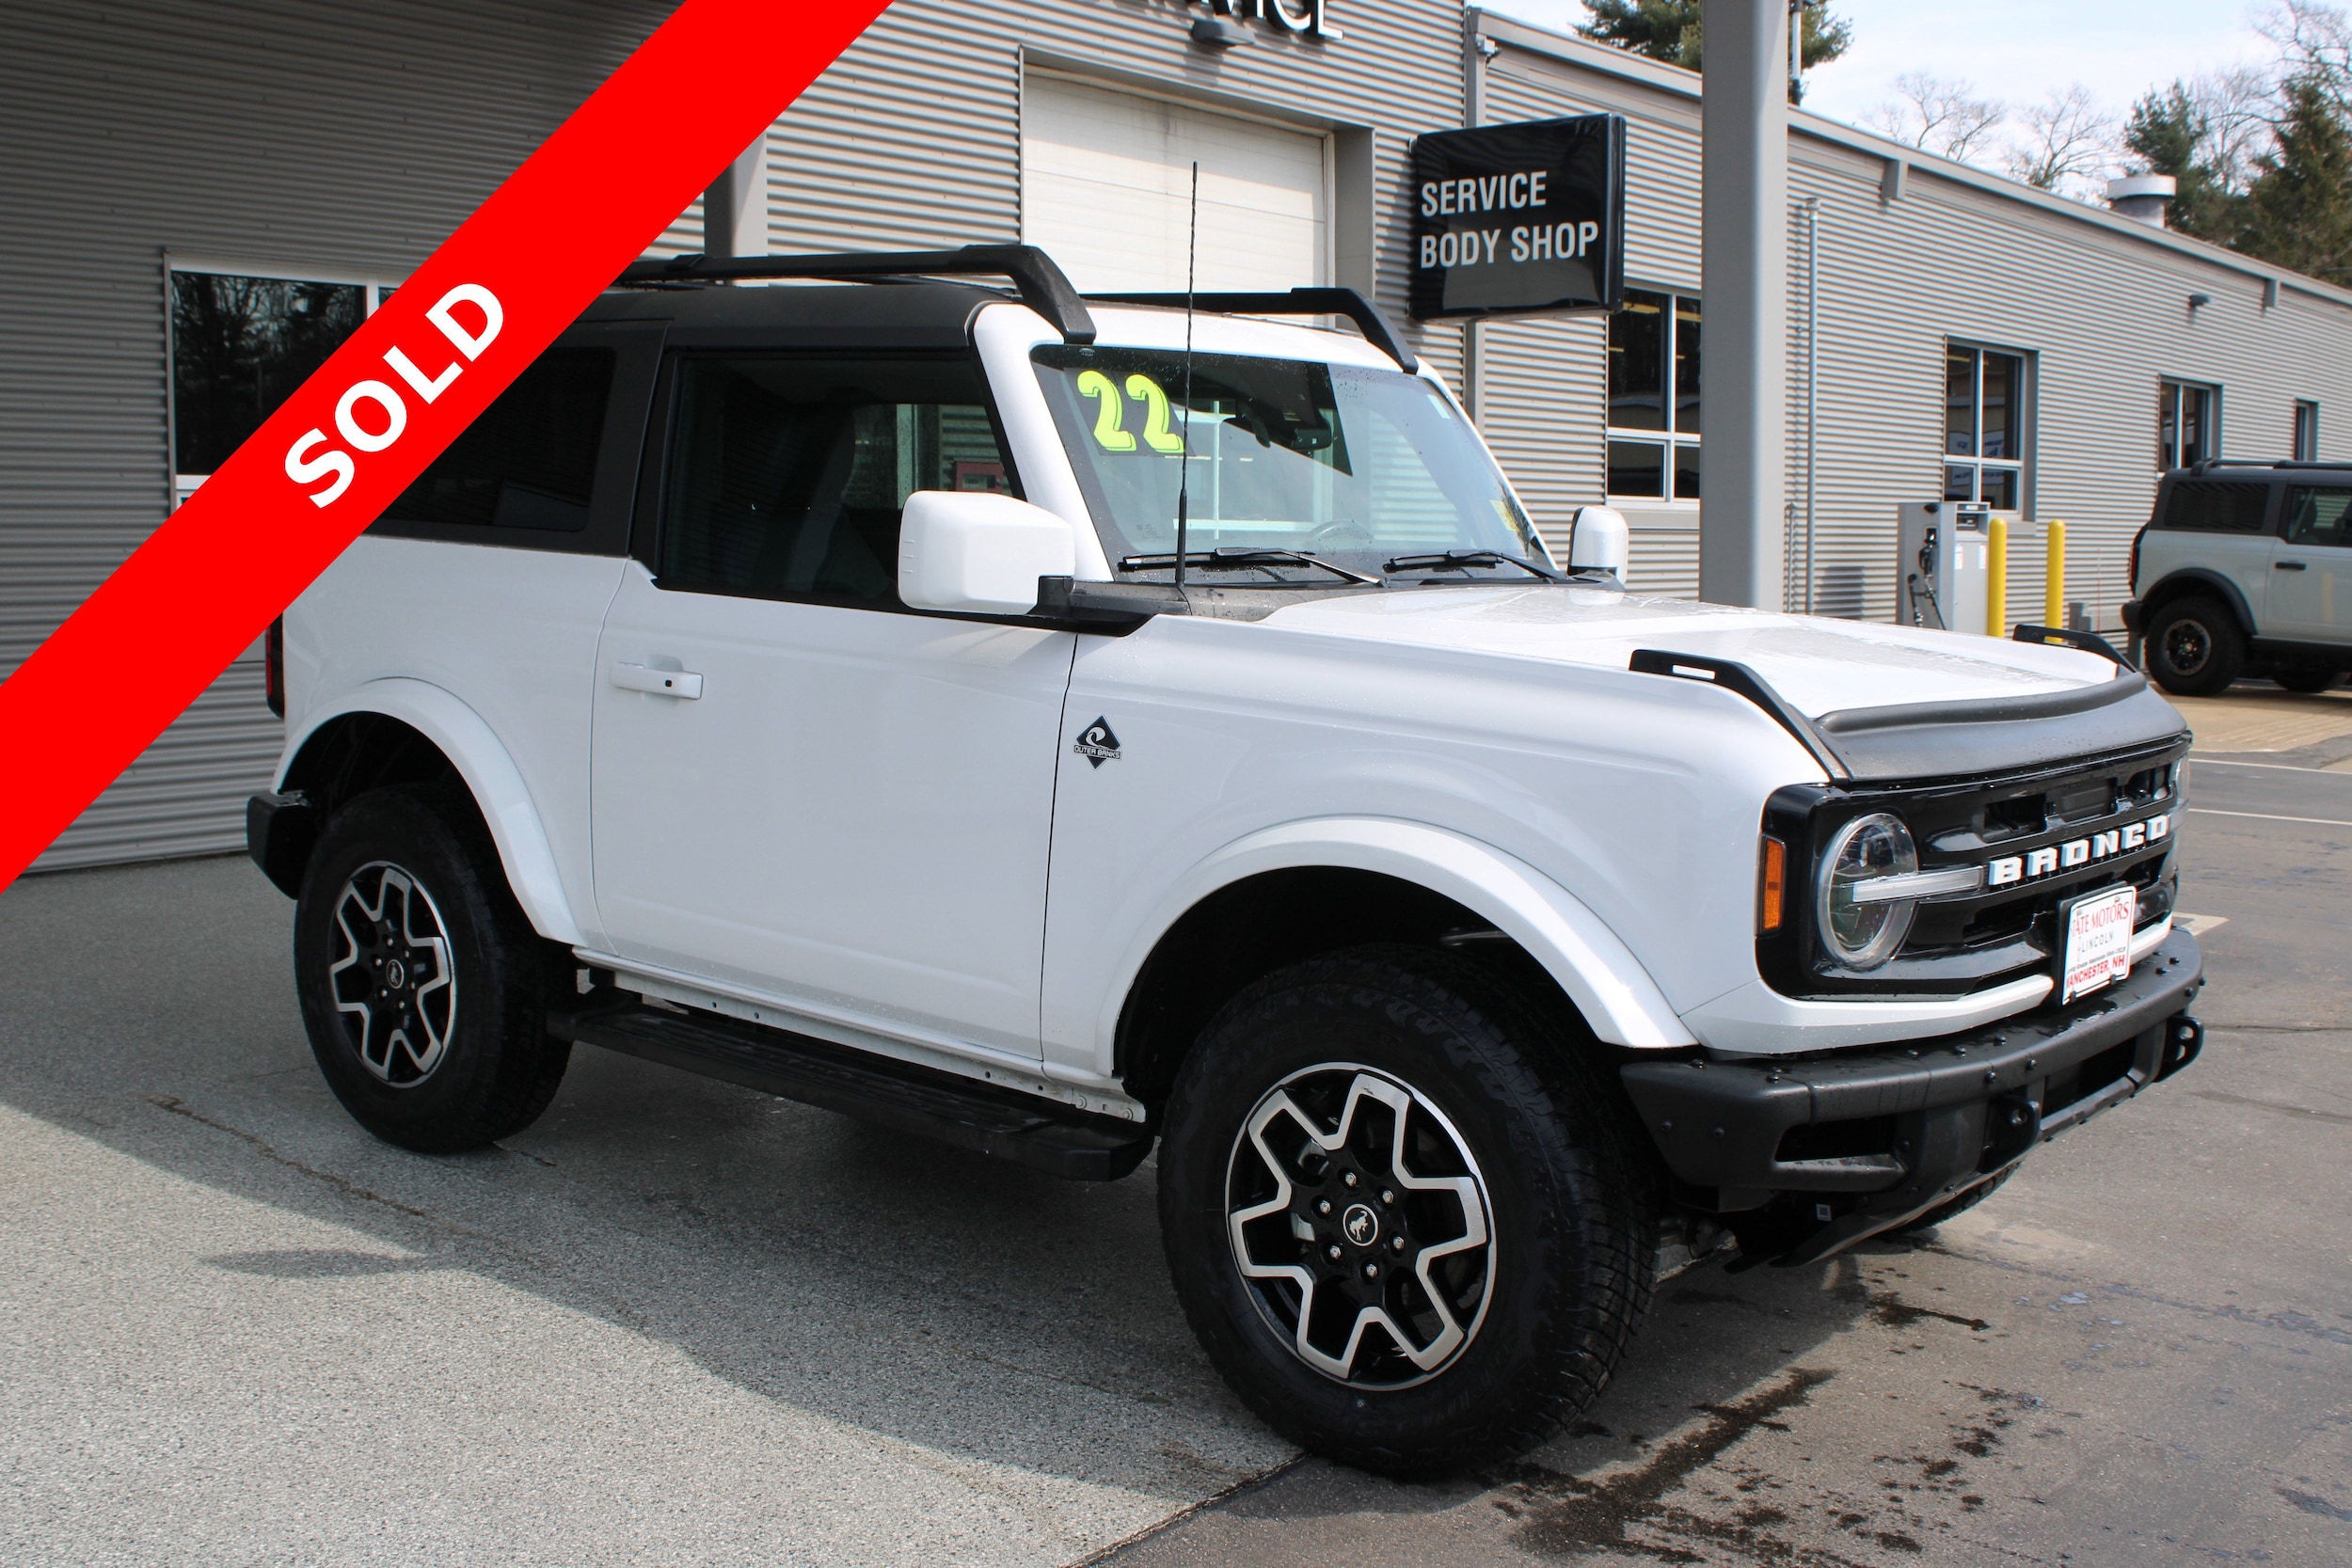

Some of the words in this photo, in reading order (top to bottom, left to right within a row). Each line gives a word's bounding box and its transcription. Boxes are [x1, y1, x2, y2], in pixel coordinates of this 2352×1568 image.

[1422, 171, 1548, 217] SERVICE
[1421, 229, 1502, 269] BODY
[1511, 221, 1598, 262] SHOP
[1077, 370, 1185, 454] 22
[1074, 745, 1097, 755] OUTER
[1988, 816, 2169, 885] BRONCO
[2091, 902, 2129, 928] MOTORS
[2081, 930, 2114, 952] LINCOLN
[2112, 954, 2125, 968] NH
